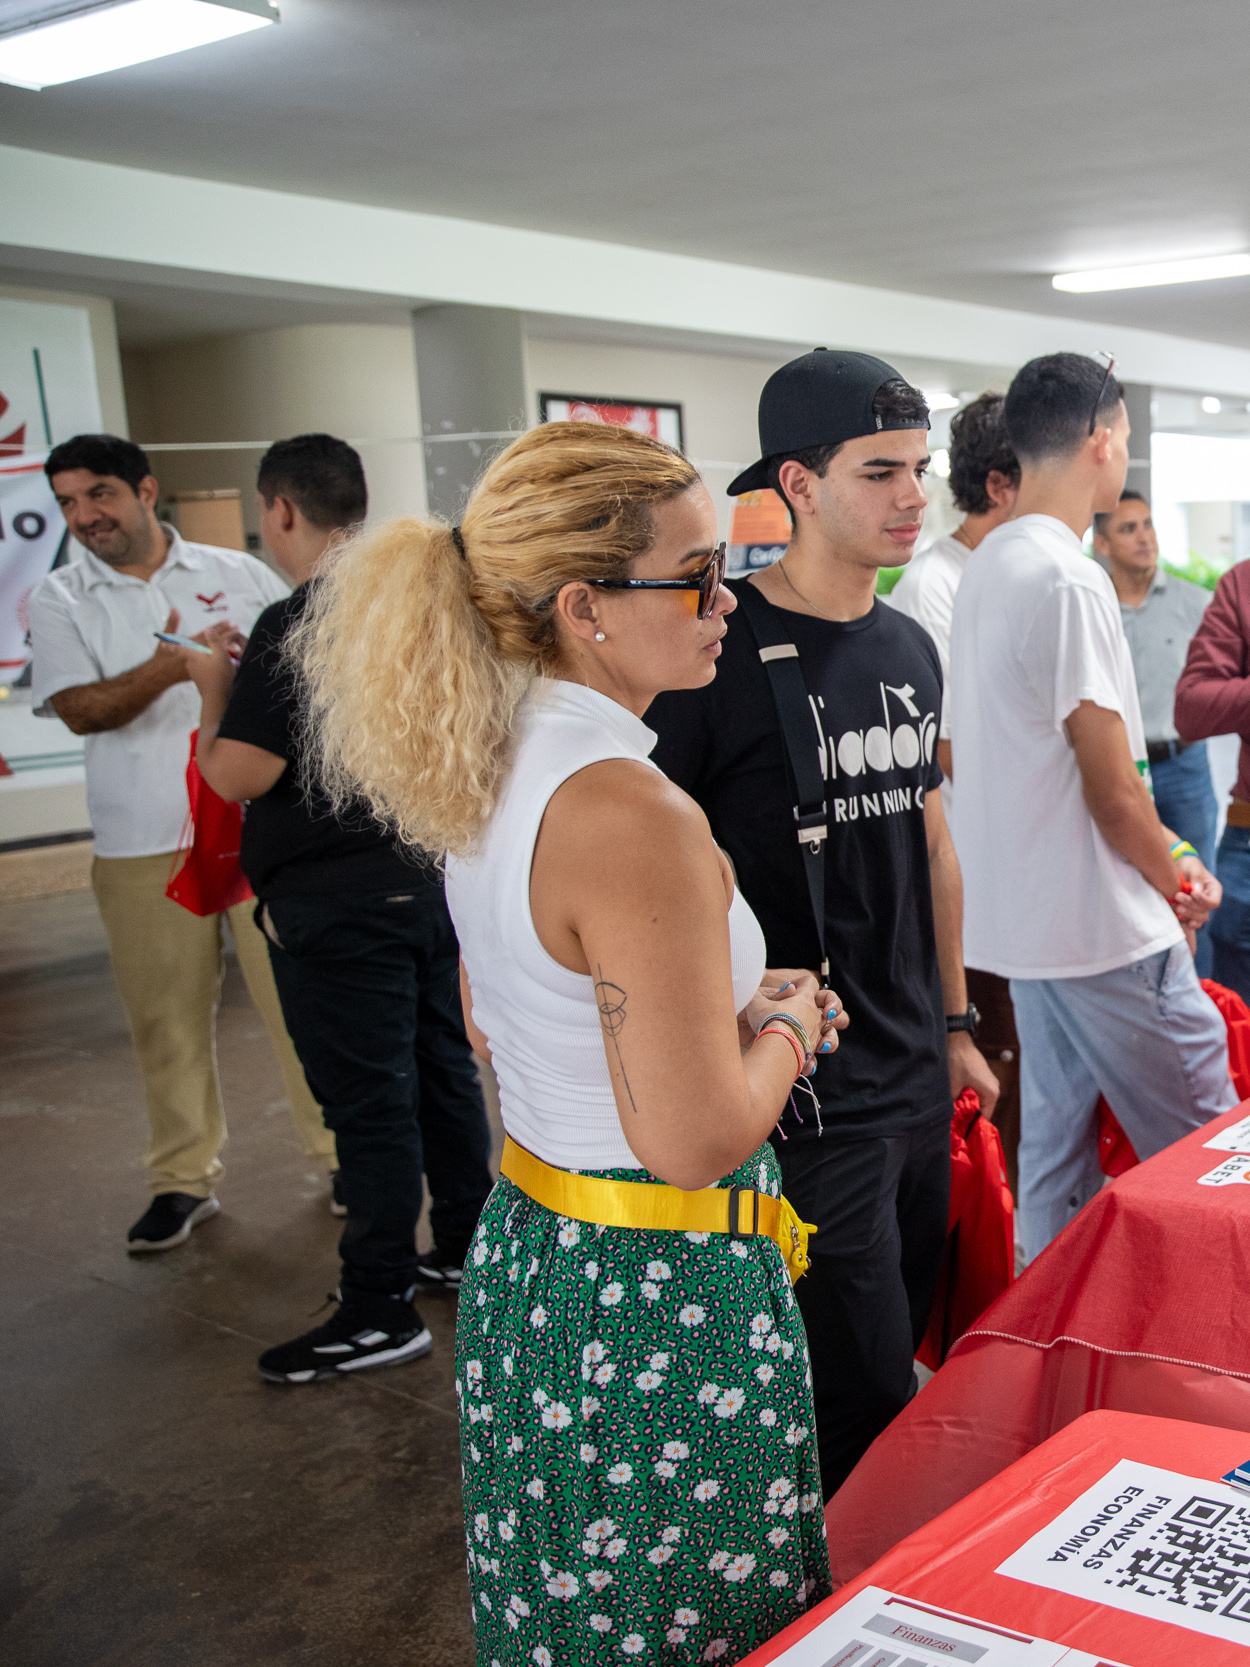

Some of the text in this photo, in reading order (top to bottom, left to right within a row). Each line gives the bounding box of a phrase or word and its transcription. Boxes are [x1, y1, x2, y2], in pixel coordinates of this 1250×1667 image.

[1204, 1156, 1250, 1184] ABET
[1046, 1485, 1145, 1562] ECONOMÍA
[1082, 1495, 1173, 1570] FINANZAS
[890, 1623, 957, 1653] Finanzas
